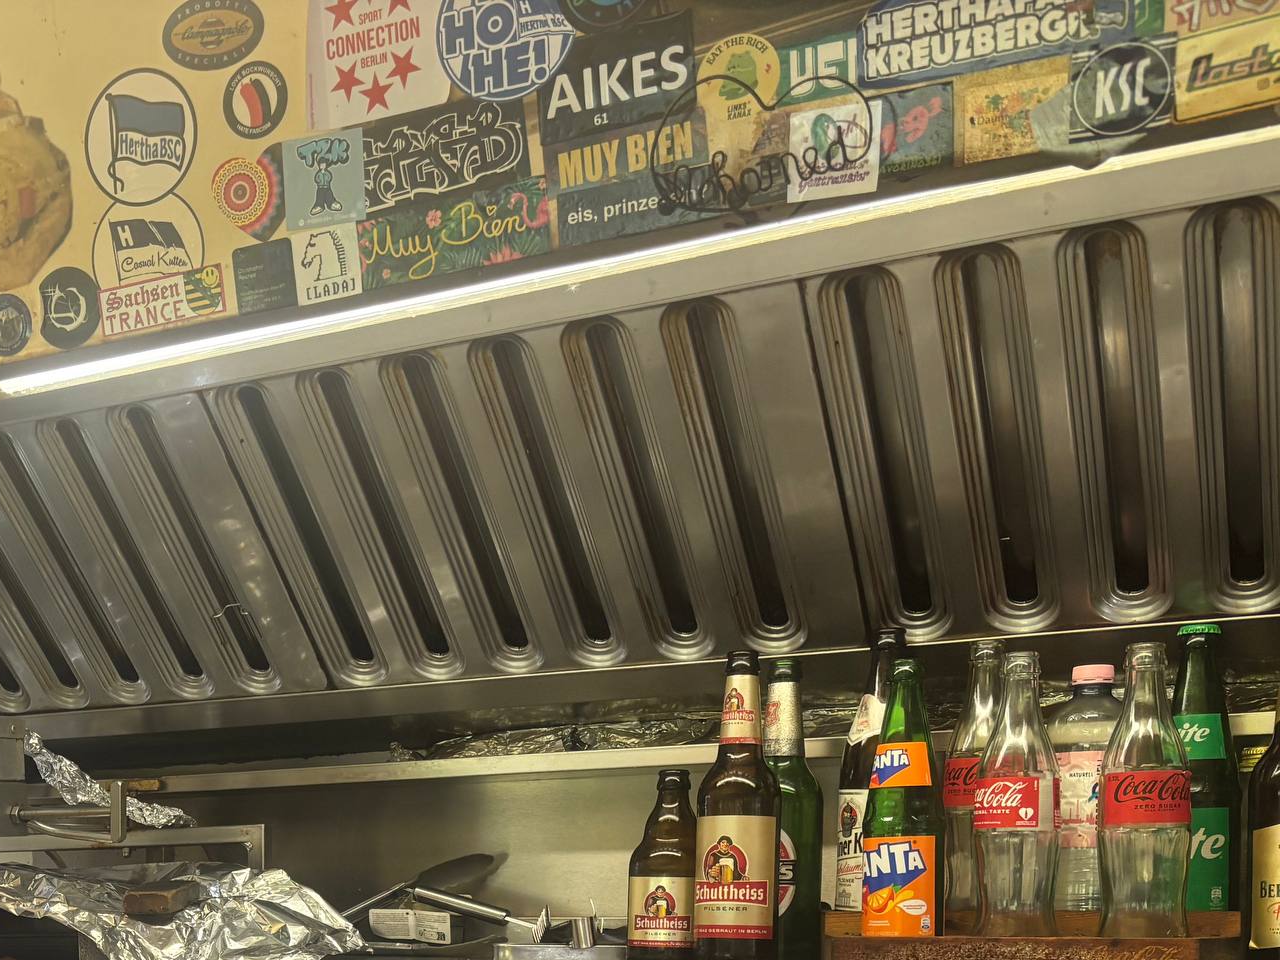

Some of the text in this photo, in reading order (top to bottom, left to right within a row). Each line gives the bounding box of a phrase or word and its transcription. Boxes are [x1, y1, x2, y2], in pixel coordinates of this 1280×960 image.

[358, 8, 383, 25] SPORT
[326, 16, 421, 60] CONNECTION
[706, 36, 769, 65] EAT THE RICH
[867, 10, 1068, 78] KREUZBERG
[360, 51, 388, 69] BERLIN
[547, 45, 689, 120] AIKES
[1095, 58, 1151, 119] KSC
[593, 113, 609, 126] 61
[558, 139, 620, 190] MUY
[626, 121, 693, 173] BIEN
[567, 204, 598, 226] eis,
[367, 202, 526, 280] Muy Bien
[105, 280, 182, 312] Sachsen
[106, 299, 186, 334] TRANCE
[873, 748, 909, 770] ANTA
[864, 843, 925, 878] ANTA
[696, 884, 765, 901] Schultheiss
[636, 917, 688, 929] Schultheiss
